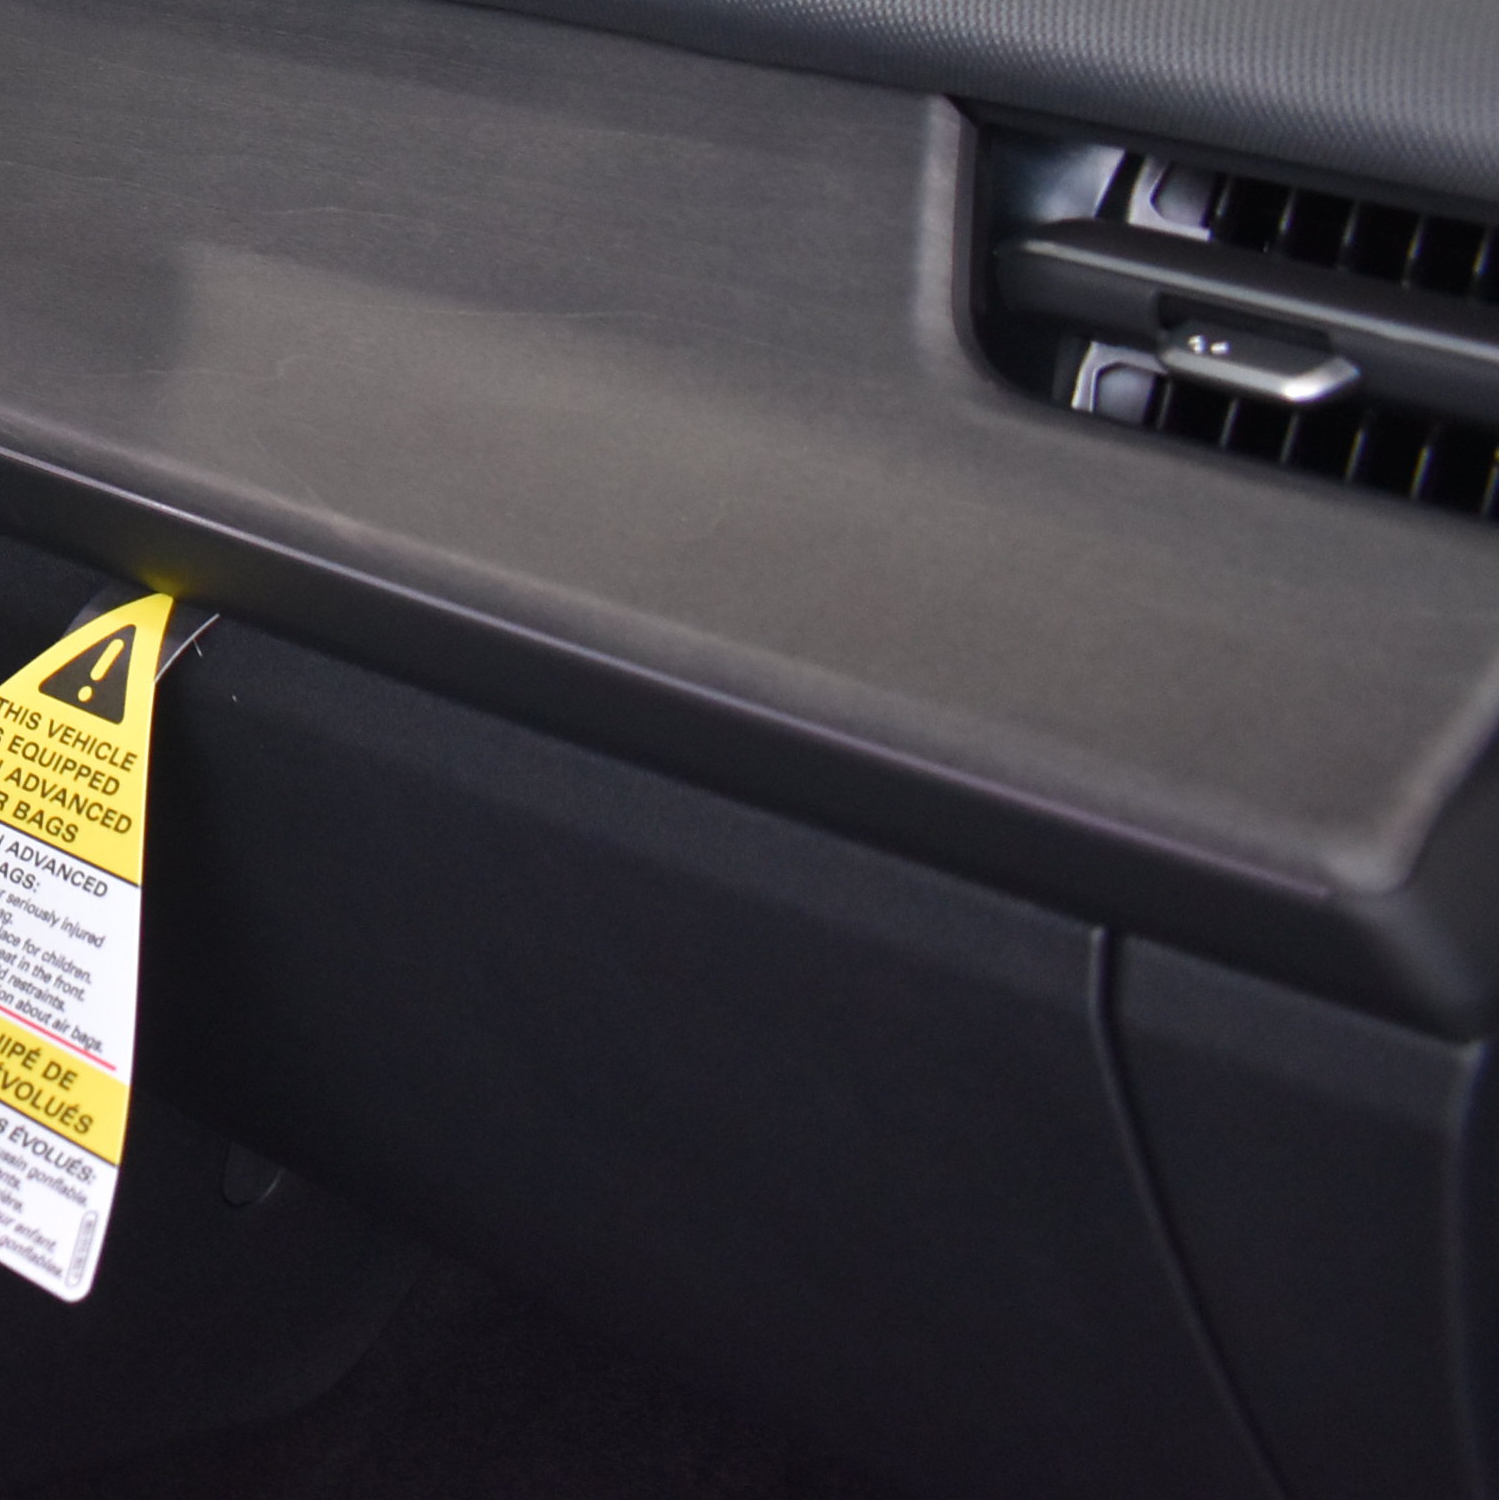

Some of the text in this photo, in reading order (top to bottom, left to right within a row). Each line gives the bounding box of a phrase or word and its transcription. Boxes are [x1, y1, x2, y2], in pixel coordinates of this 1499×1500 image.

[7, 734, 120, 796] EQUIPPED
[47, 718, 138, 773] VEHICLE
[3, 767, 133, 834] ADVANCED
[12, 800, 79, 844] BAGS
[4, 840, 108, 898] ADVANCED
[5, 893, 61, 928] seriously
[60, 916, 106, 949] injured
[16, 955, 31, 973] in
[31, 964, 53, 984] the
[52, 974, 85, 1002] front.
[21, 937, 42, 957] for
[40, 950, 92, 985] children.
[7, 974, 65, 1013] restraints.
[14, 999, 53, 1026] about
[51, 1018, 71, 1034] air
[70, 1025, 103, 1053] bags.
[41, 1060, 78, 1091] DE
[7, 1125, 96, 1185] ÉVOLUÉS:
[25, 1167, 88, 1208] gonflable.
[13, 1223, 57, 1253] enfant.
